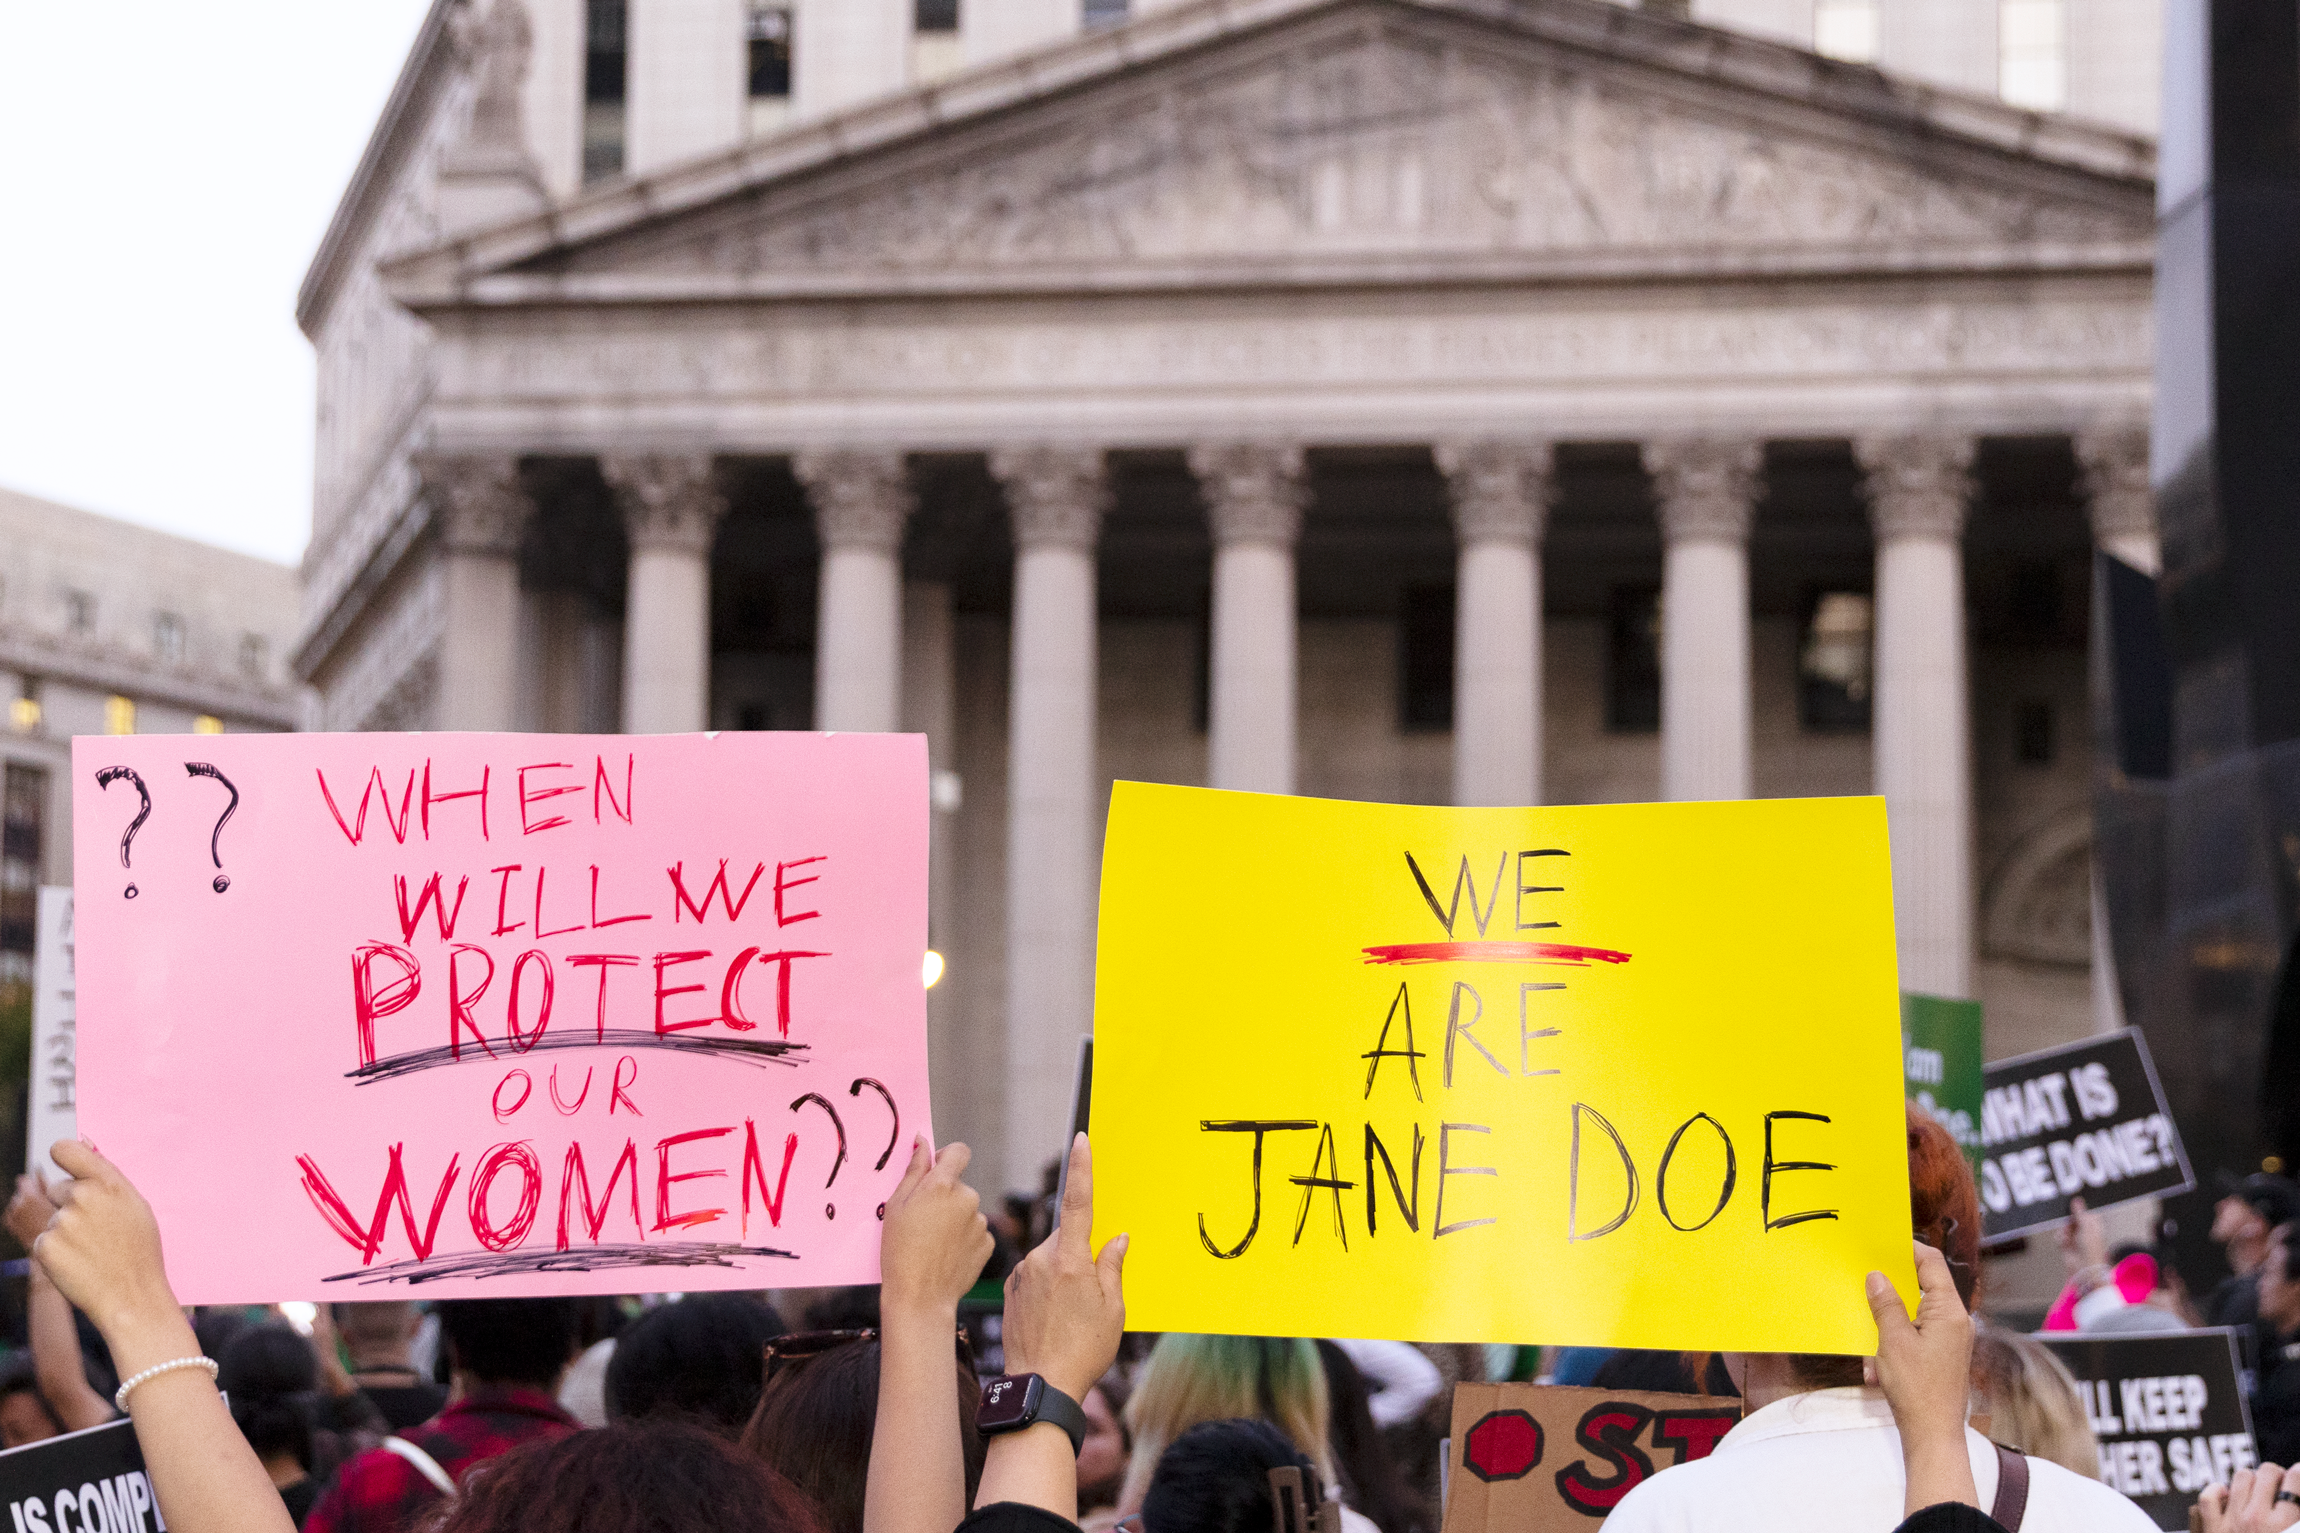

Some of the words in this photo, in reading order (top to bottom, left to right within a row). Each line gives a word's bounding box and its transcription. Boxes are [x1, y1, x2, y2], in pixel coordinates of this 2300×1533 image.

[316, 753, 634, 847] WHEN
[394, 864, 653, 946] WILL
[666, 855, 829, 929] WE
[1403, 848, 1572, 939] WE
[351, 940, 833, 1071] PROTECT
[1360, 981, 1569, 1104] ARE
[492, 1055, 643, 1125] OUR
[2069, 1061, 2119, 1122] IS
[1197, 1119, 1499, 1260] JANE
[1568, 1102, 1840, 1245] DOE
[1979, 1158, 2011, 1216] O
[2000, 1145, 2059, 1207] BE
[2047, 1112, 2177, 1196] DONE?
[990, 1382, 1004, 1404] 6:41
[2119, 1373, 2208, 1435] KEEP
[2167, 1432, 2257, 1494] SAFE
